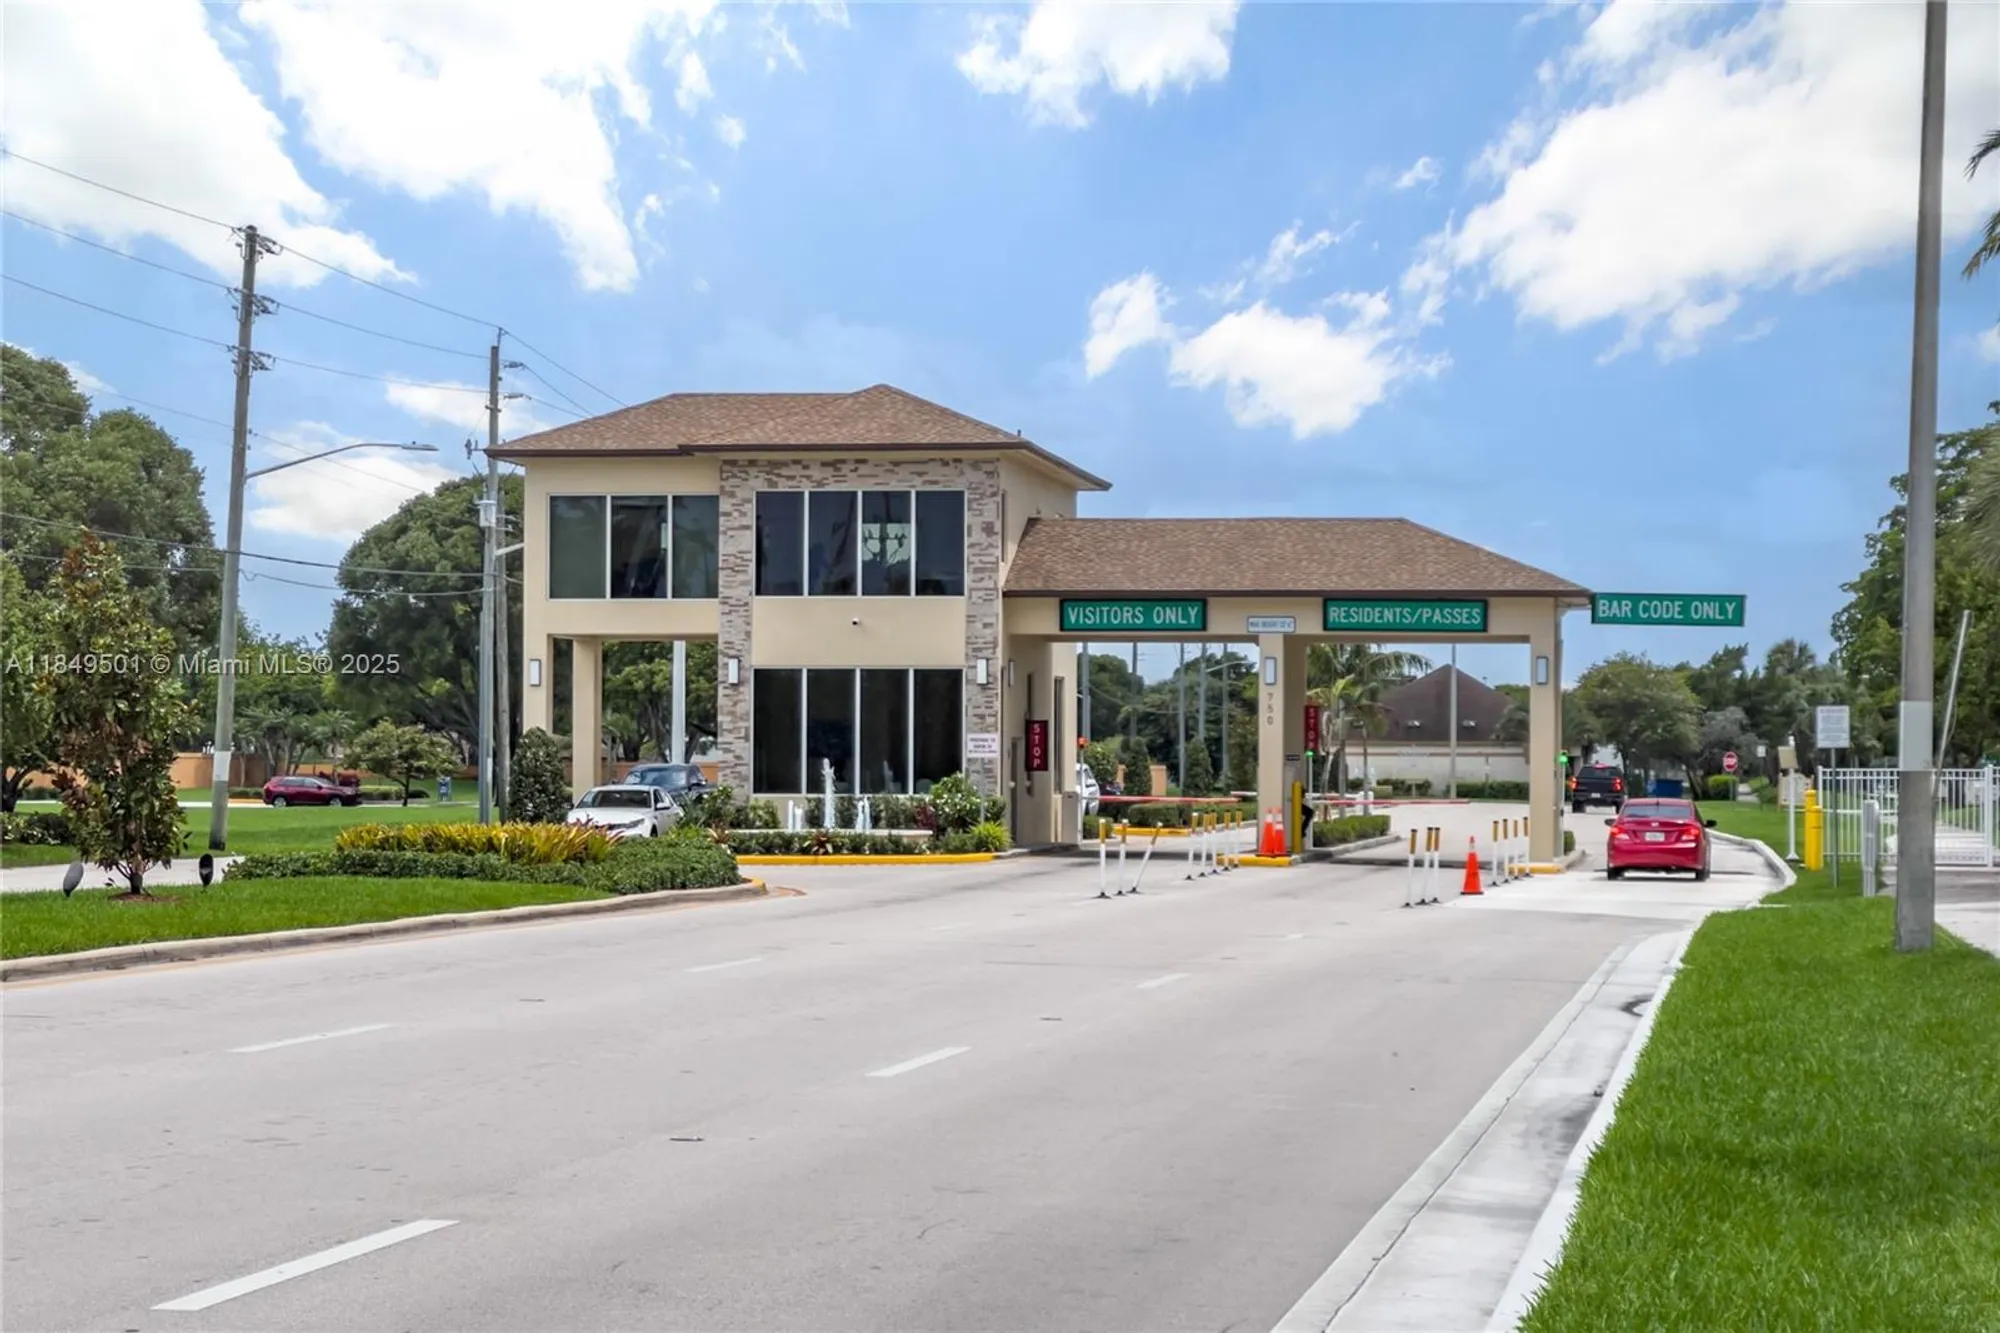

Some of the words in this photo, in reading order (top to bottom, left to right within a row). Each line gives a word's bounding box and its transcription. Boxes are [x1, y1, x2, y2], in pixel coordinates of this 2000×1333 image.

[1068, 606, 1144, 625] VISITORS
[1153, 606, 1199, 625] ONLY
[1329, 606, 1481, 625] RESIDENTS/PASSES
[1598, 599, 1632, 618] BAR
[1638, 600, 1684, 619] CODE
[1690, 601, 1736, 620] ONLY
[1032, 723, 1041, 768] STOP
